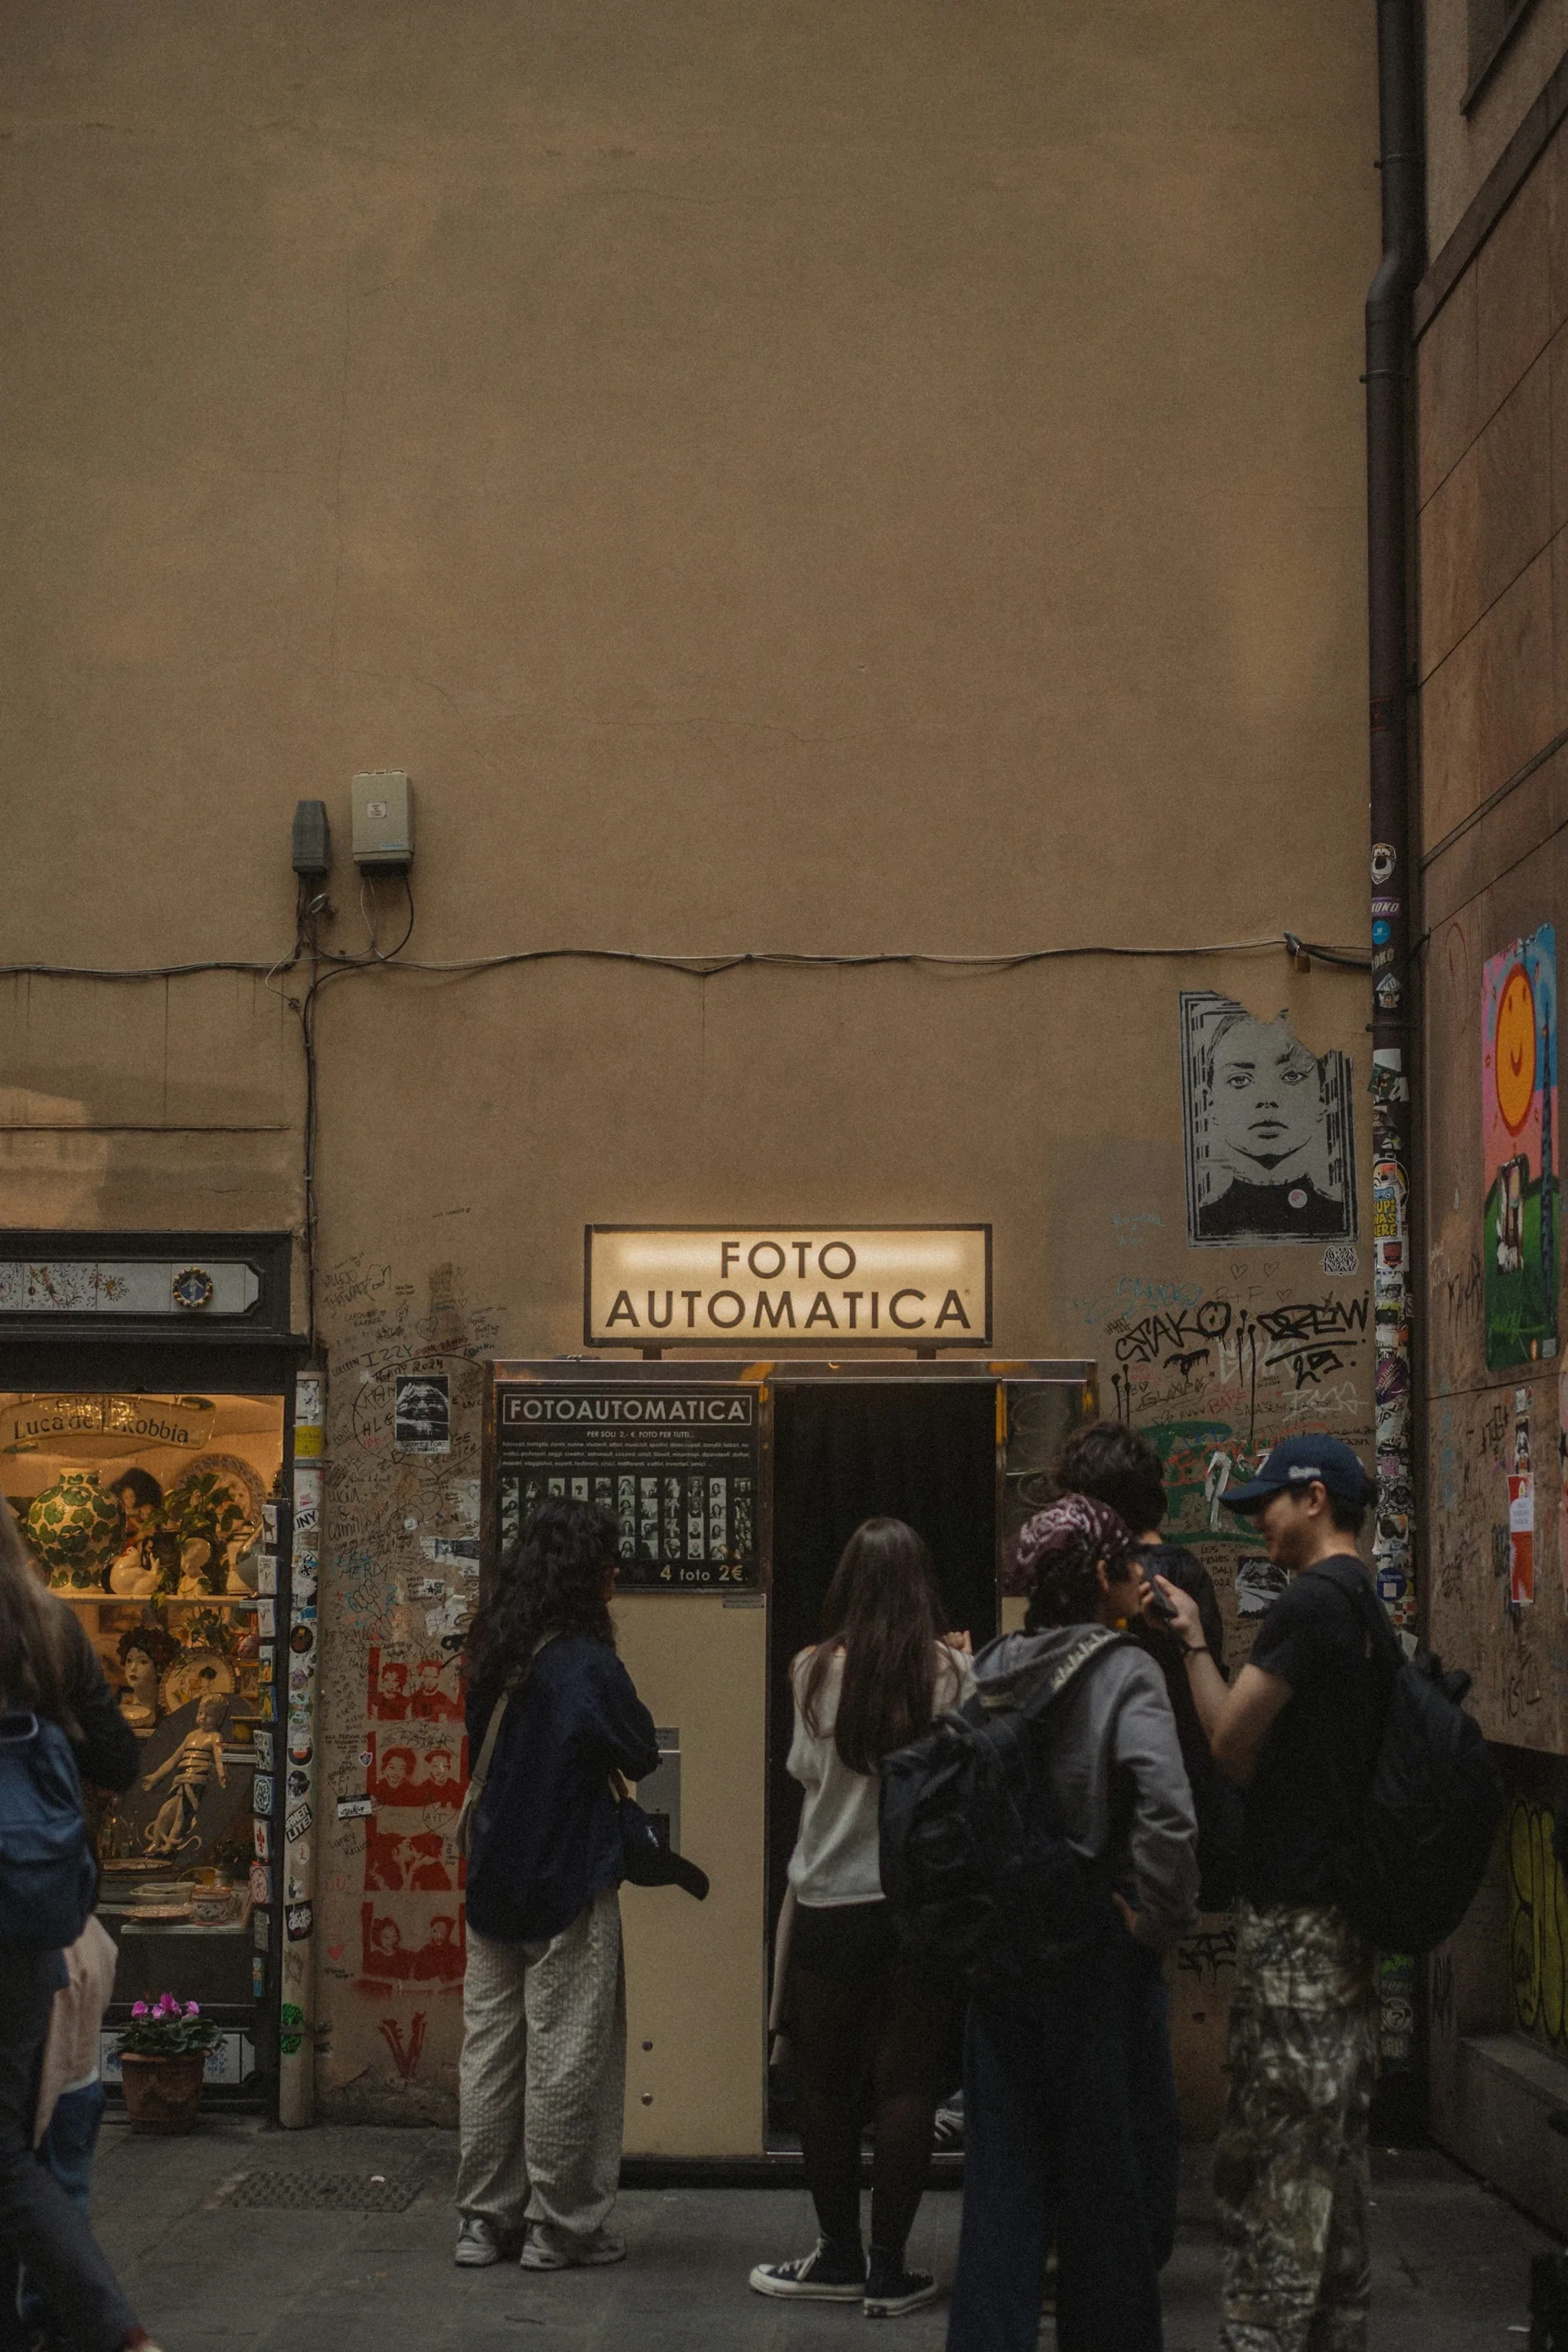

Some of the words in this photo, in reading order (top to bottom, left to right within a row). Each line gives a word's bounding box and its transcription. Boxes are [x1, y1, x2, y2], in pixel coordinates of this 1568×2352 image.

[721, 1241, 856, 1278] FOTO
[606, 1290, 970, 1329] AUTOMATICA
[510, 1400, 745, 1419] FOTOAUTOMATICA
[14, 1415, 64, 1440] Luca
[660, 1564, 673, 1581] 4
[679, 1568, 710, 1581] foto
